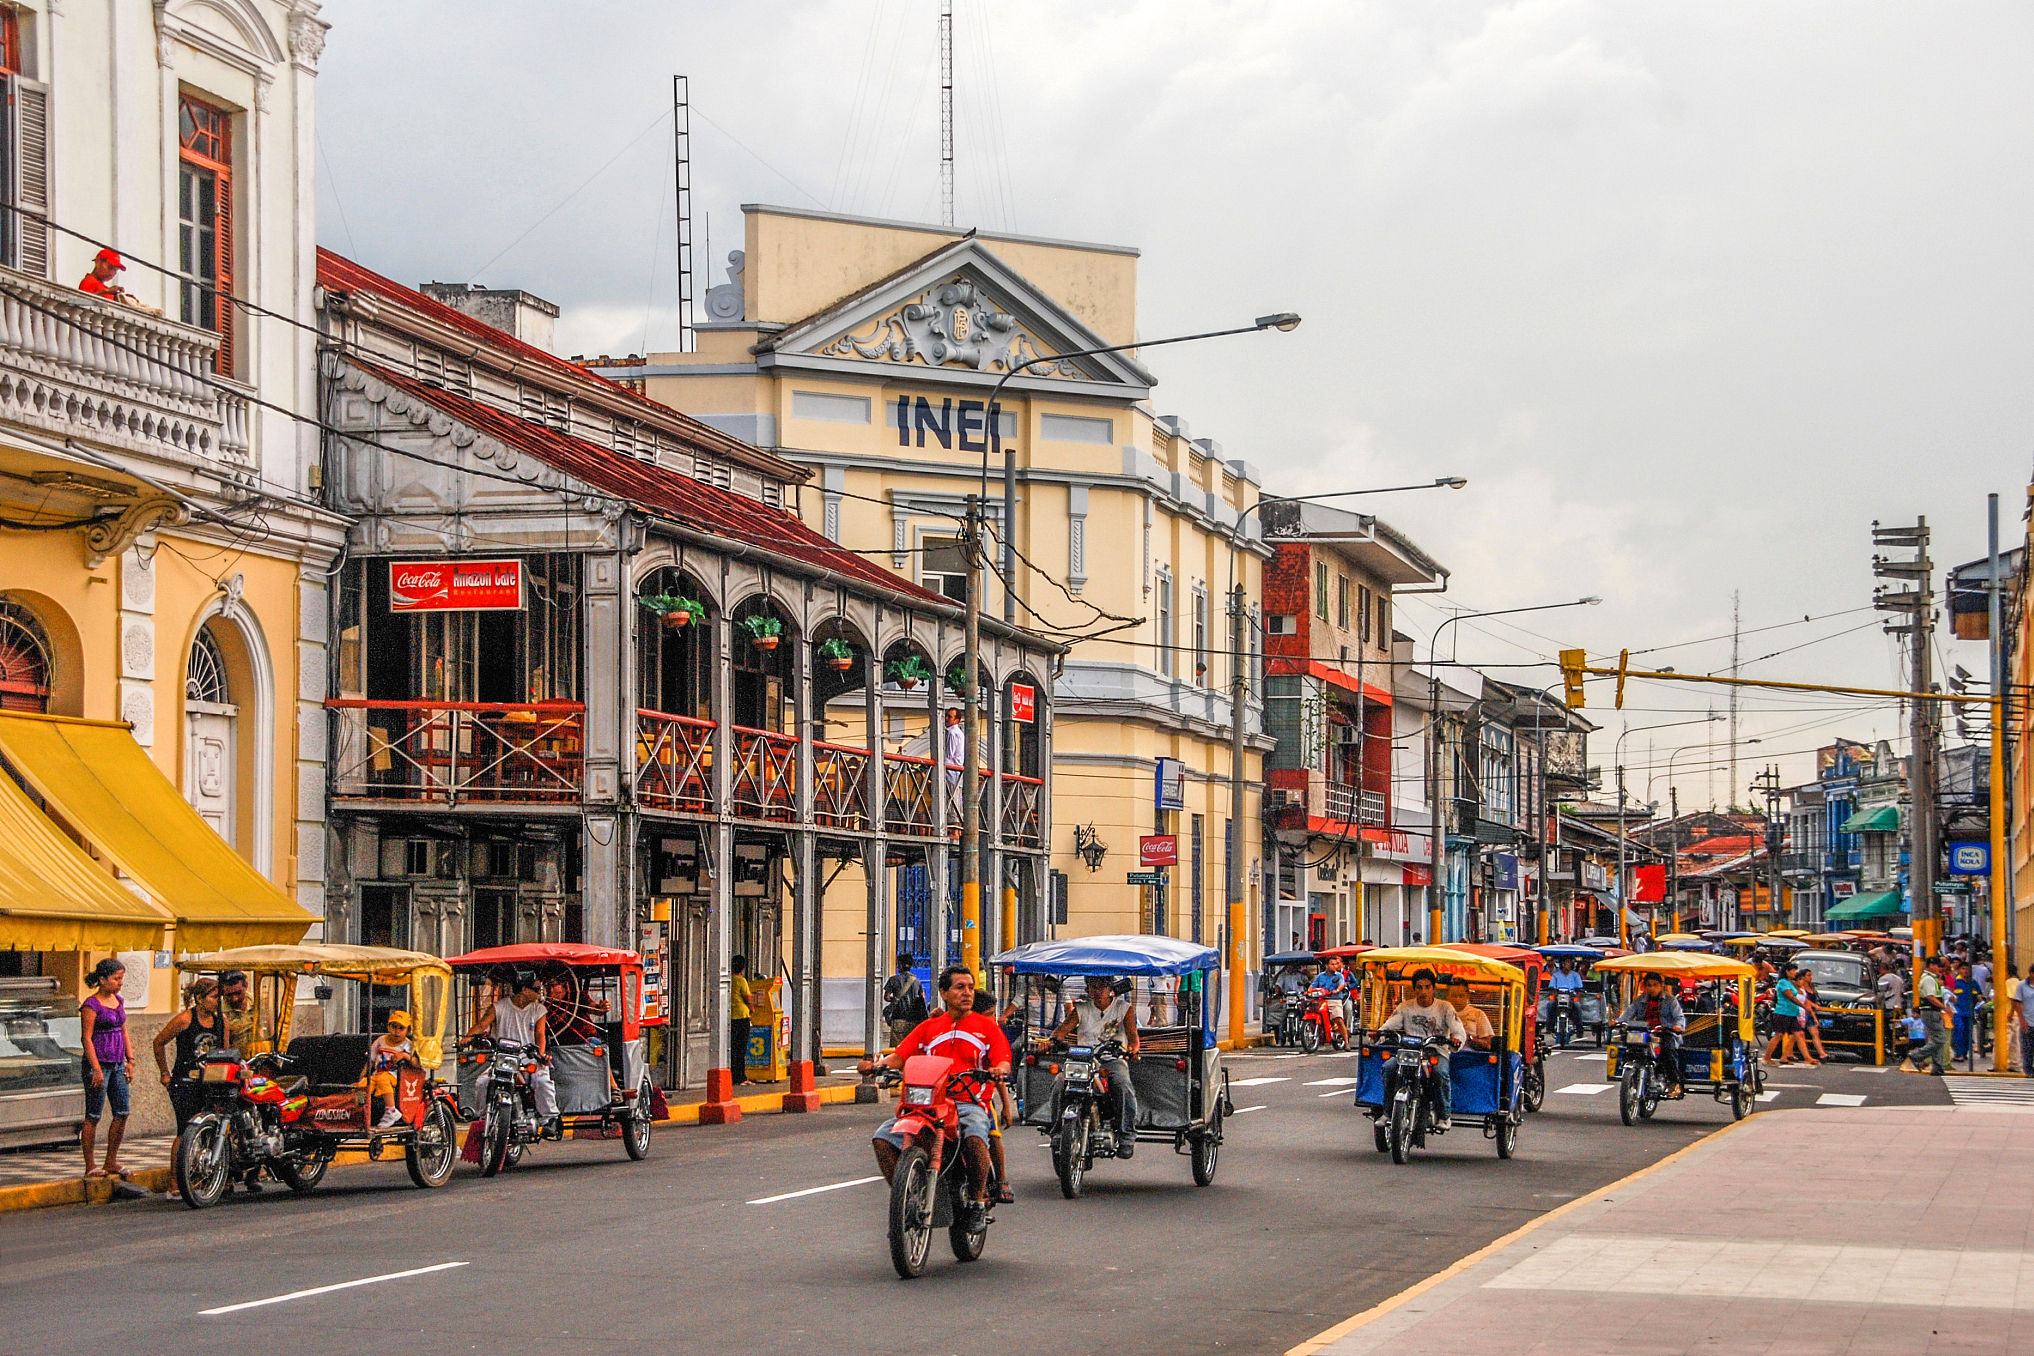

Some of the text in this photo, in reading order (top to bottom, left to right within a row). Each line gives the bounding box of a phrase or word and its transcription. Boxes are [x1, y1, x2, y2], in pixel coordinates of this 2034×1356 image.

[898, 395, 1000, 453] INEI
[453, 566, 516, 588] Amazon Cafe
[453, 588, 516, 596] Restaurant
[750, 1037, 765, 1056] 3
